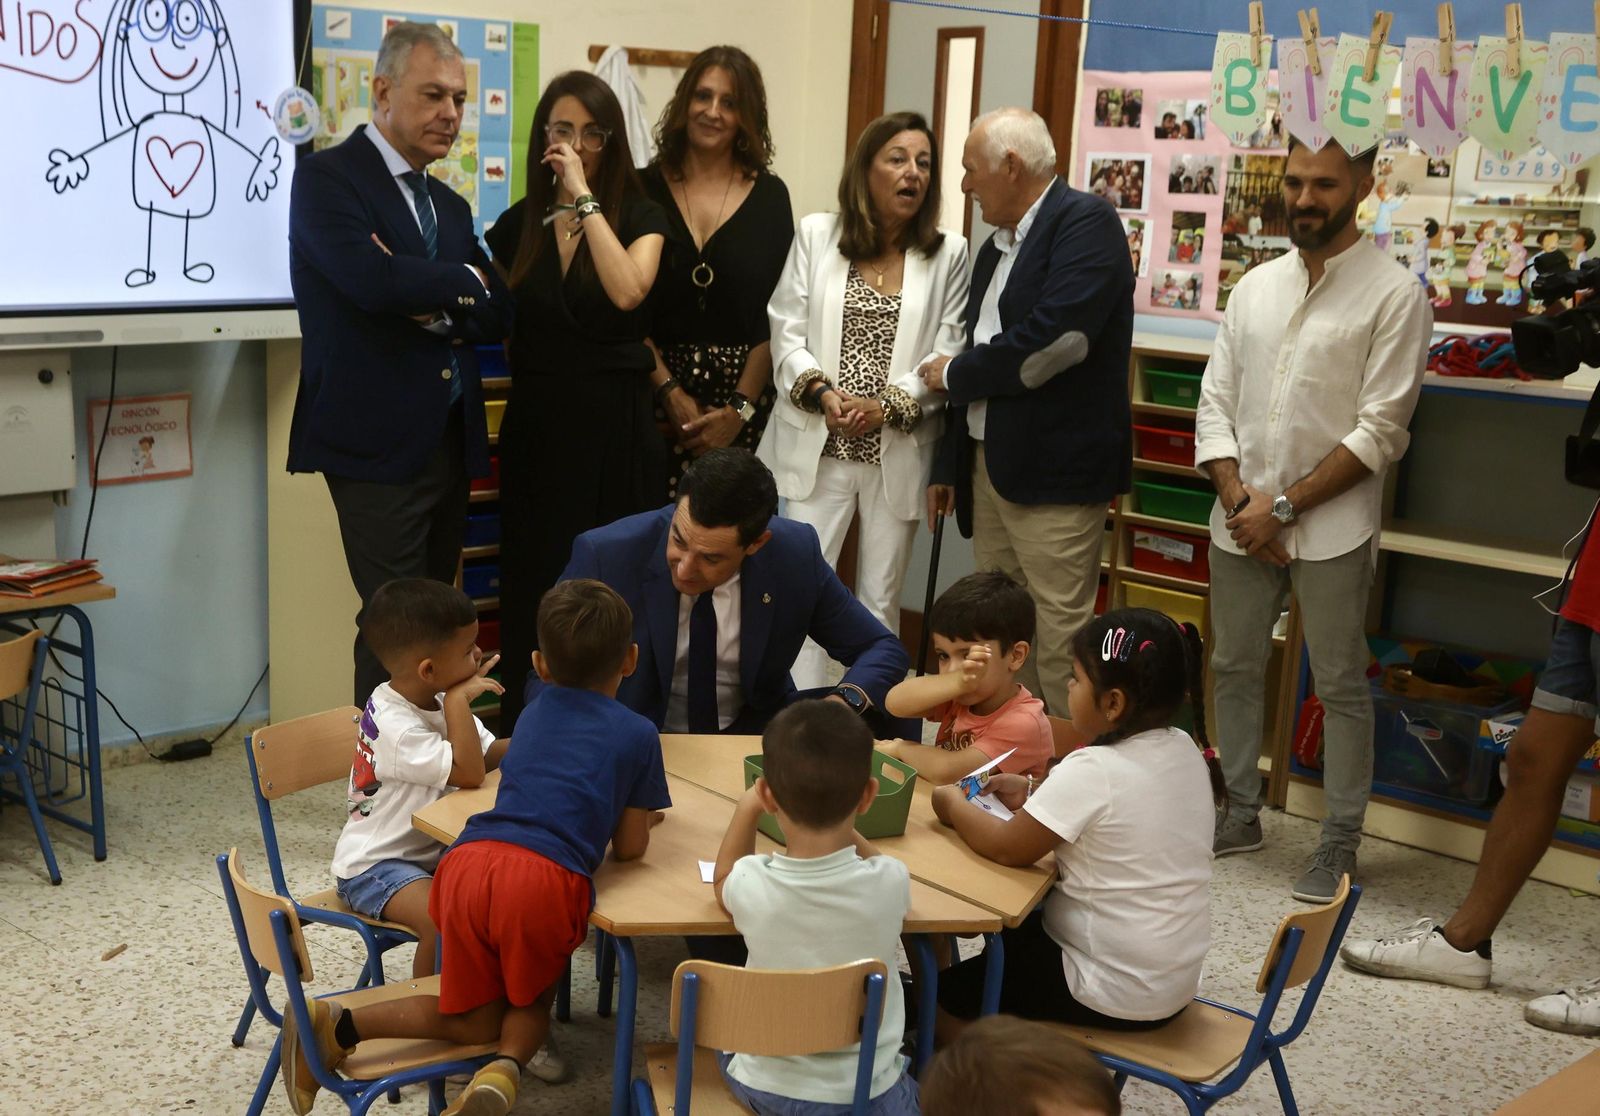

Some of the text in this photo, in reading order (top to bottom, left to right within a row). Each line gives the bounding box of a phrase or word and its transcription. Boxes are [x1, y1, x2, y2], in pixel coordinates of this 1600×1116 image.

[1484, 160, 1561, 177] 5 6 7 8 9
[121, 406, 160, 419] RINCÓN
